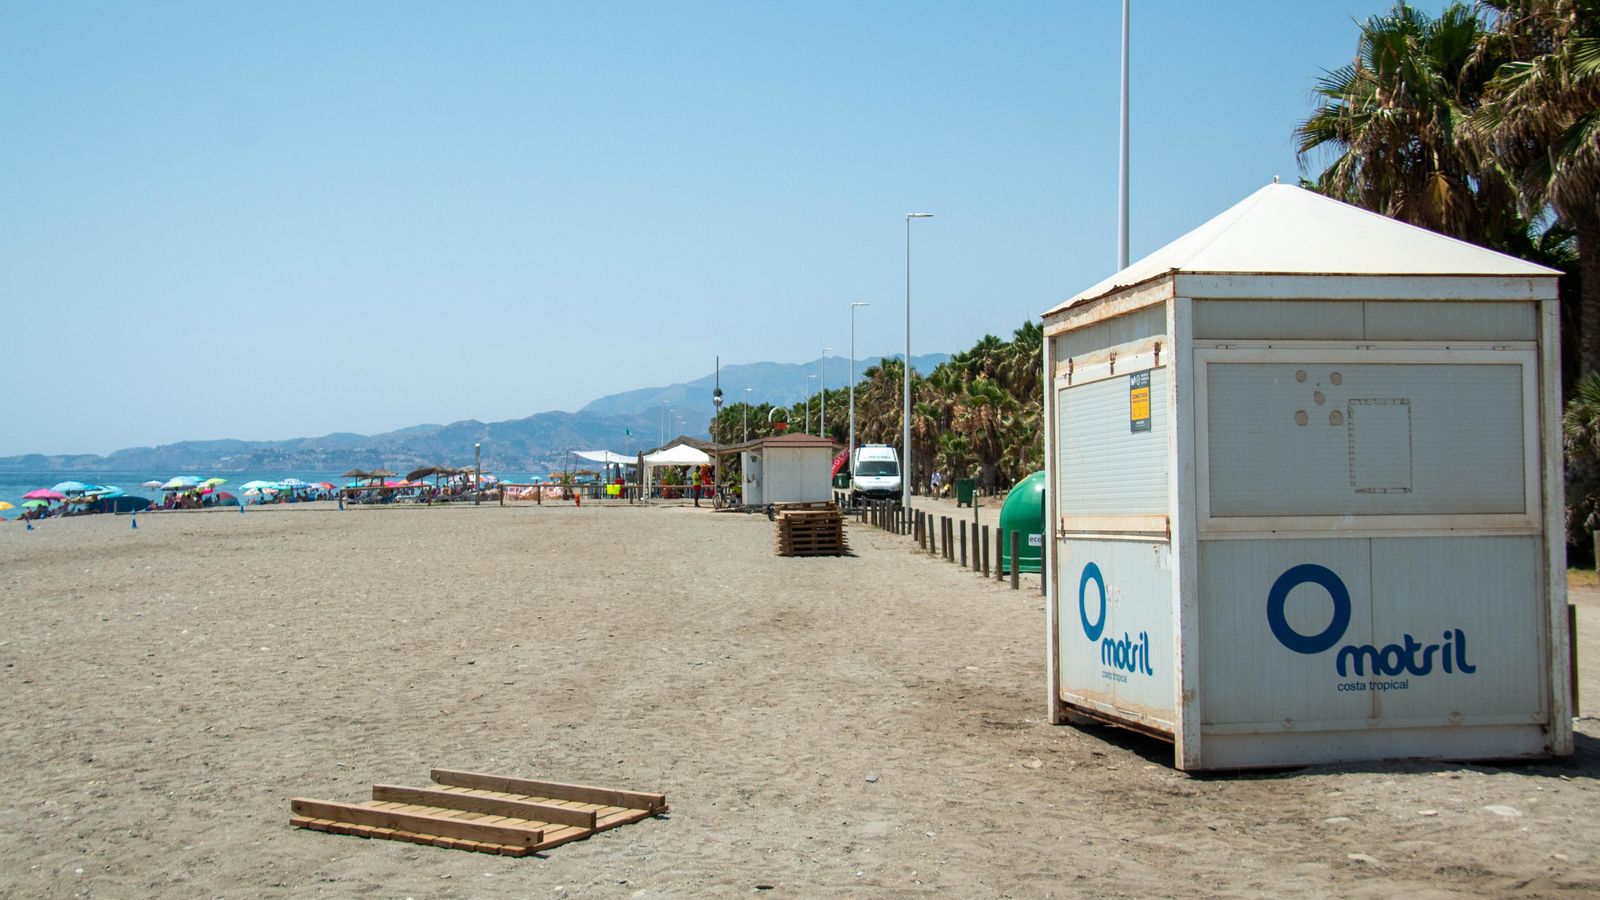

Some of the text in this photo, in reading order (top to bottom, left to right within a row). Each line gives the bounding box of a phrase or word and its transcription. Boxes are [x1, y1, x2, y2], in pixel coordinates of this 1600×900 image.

[1101, 630, 1153, 676] motril
[1336, 628, 1476, 677] motril
[1337, 679, 1409, 692] costa tropical
